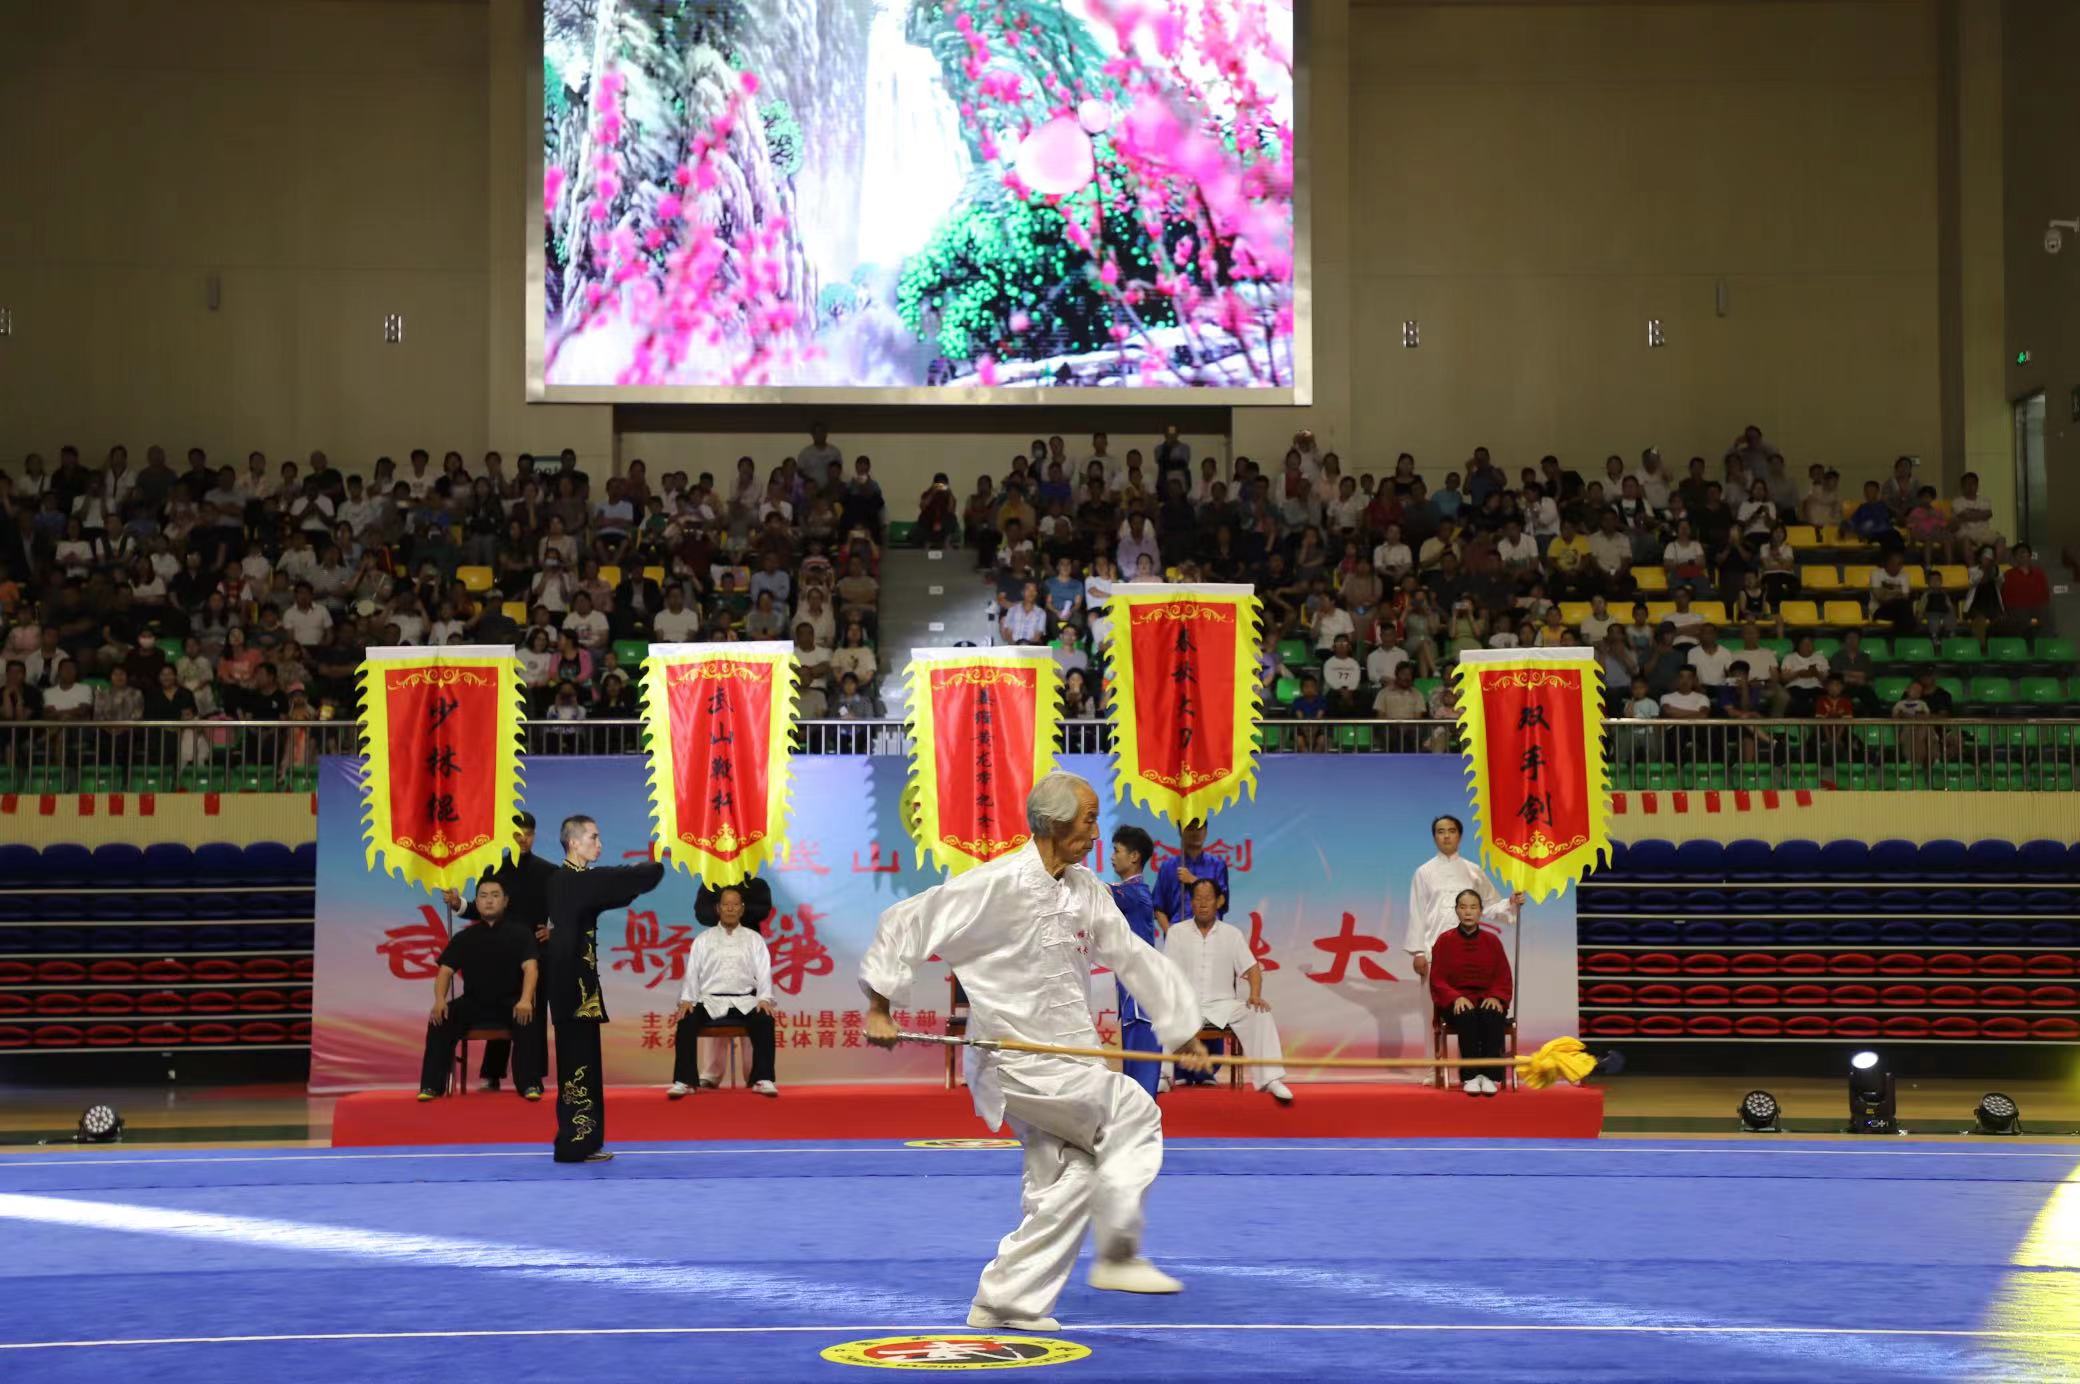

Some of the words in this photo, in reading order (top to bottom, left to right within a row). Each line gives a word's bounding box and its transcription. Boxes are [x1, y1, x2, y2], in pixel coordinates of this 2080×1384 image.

[1170, 626, 1198, 750] 春秋大刀
[427, 696, 462, 823] 少林棍
[1516, 704, 1553, 828] 双手剑
[1305, 911, 1399, 984] 大
